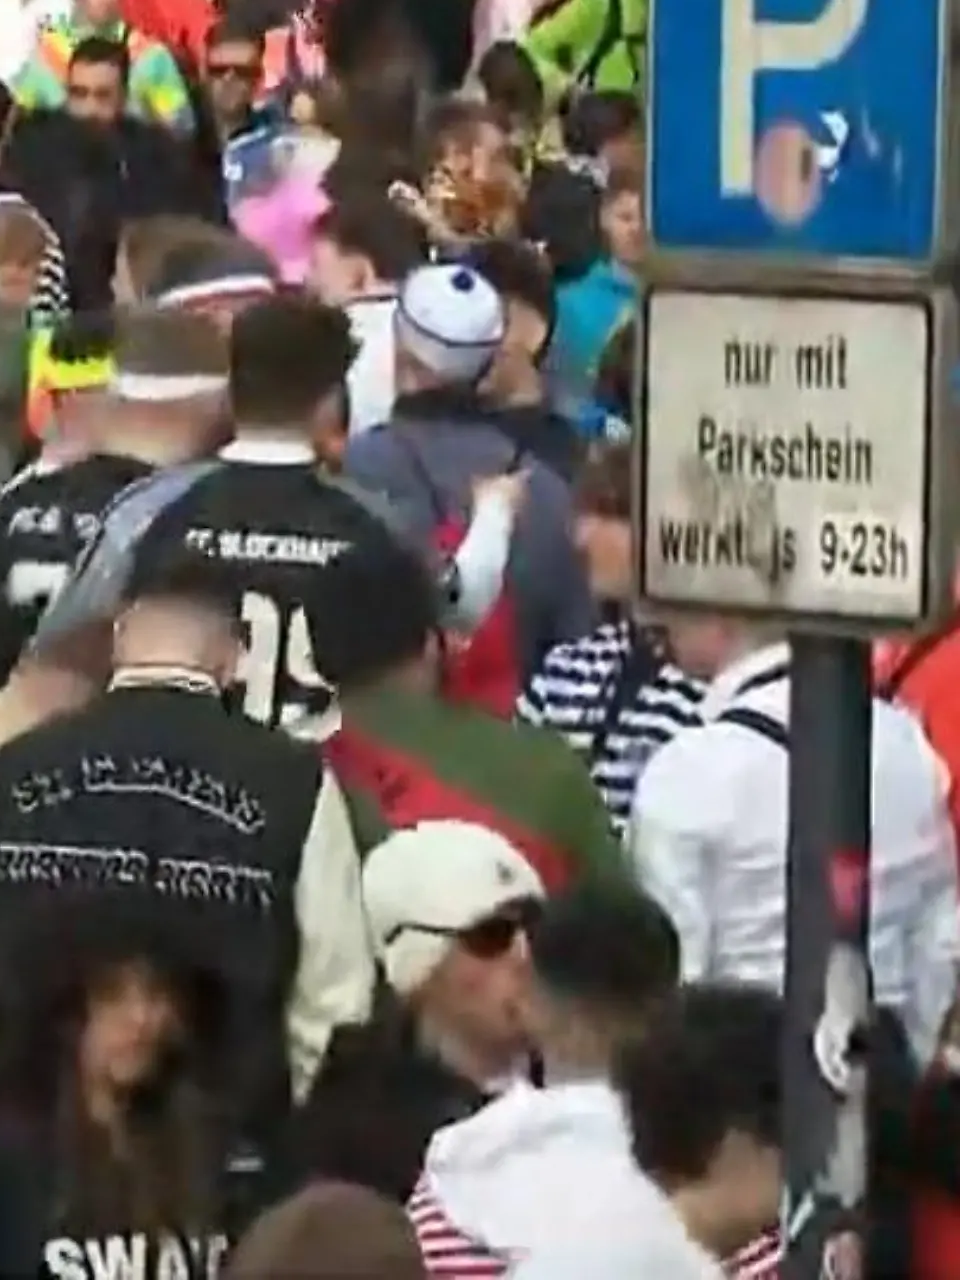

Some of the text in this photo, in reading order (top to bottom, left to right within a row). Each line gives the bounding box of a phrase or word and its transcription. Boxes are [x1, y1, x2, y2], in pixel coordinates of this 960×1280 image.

[724, 333, 847, 390] nur mit
[697, 413, 873, 487] Parkschein
[659, 515, 797, 587] werkts
